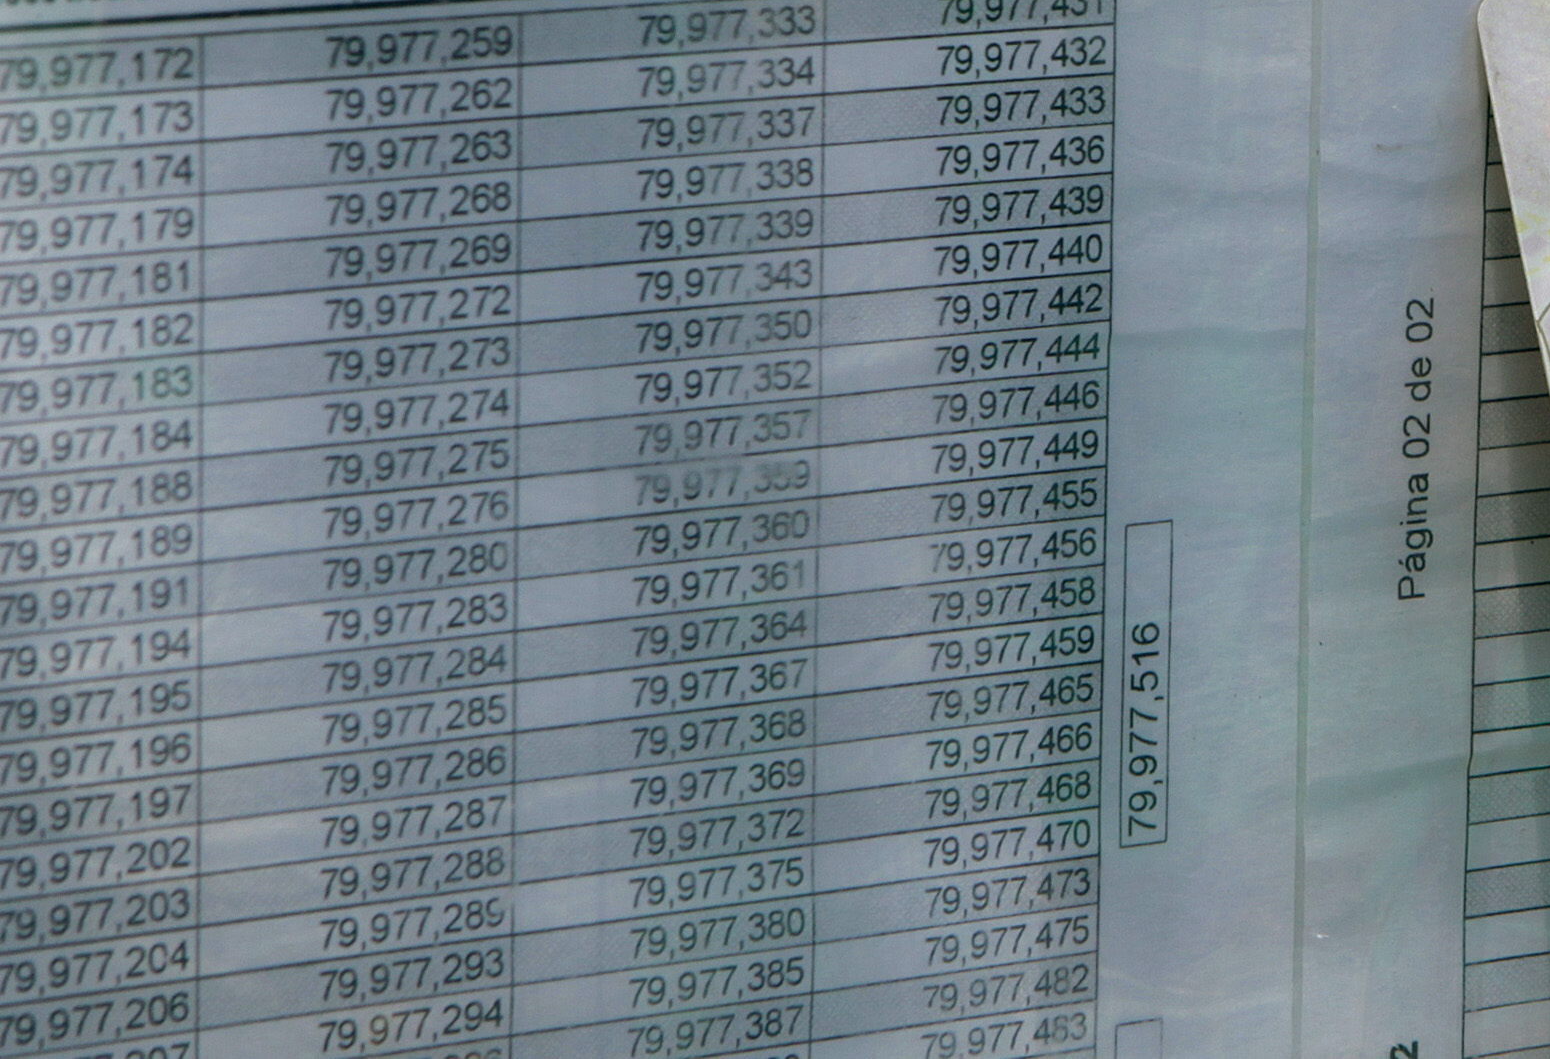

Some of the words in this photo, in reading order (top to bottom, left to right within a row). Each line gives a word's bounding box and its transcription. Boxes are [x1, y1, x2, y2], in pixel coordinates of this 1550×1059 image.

[326, 25, 513, 70] 79,977,259
[638, 5, 816, 48] 79,977,333
[937, 85, 1105, 128] 79,977,433
[326, 181, 512, 227] 79,977,268
[935, 184, 1104, 229] 79,977,439
[636, 259, 812, 304] 79,977,343
[1406, 297, 1434, 343] 02
[324, 333, 510, 385] 79,977,273
[935, 333, 1100, 376] 79,977,444
[1405, 357, 1432, 401] de
[1402, 413, 1431, 458] 02
[1398, 473, 1433, 600] Página
[323, 592, 508, 641] 79,977,283
[929, 576, 1095, 623] 79,977,458
[632, 610, 807, 659] 79,977,364
[926, 722, 1092, 771] 79,977,466
[1132, 622, 1164, 837] 79,977,516
[322, 745, 506, 797] 79,977,286
[631, 758, 805, 808] 79,977,369
[925, 914, 1089, 965] 79,977,475
[319, 942, 504, 1002] 79,977,293
[629, 956, 804, 1008] 79,977,385
